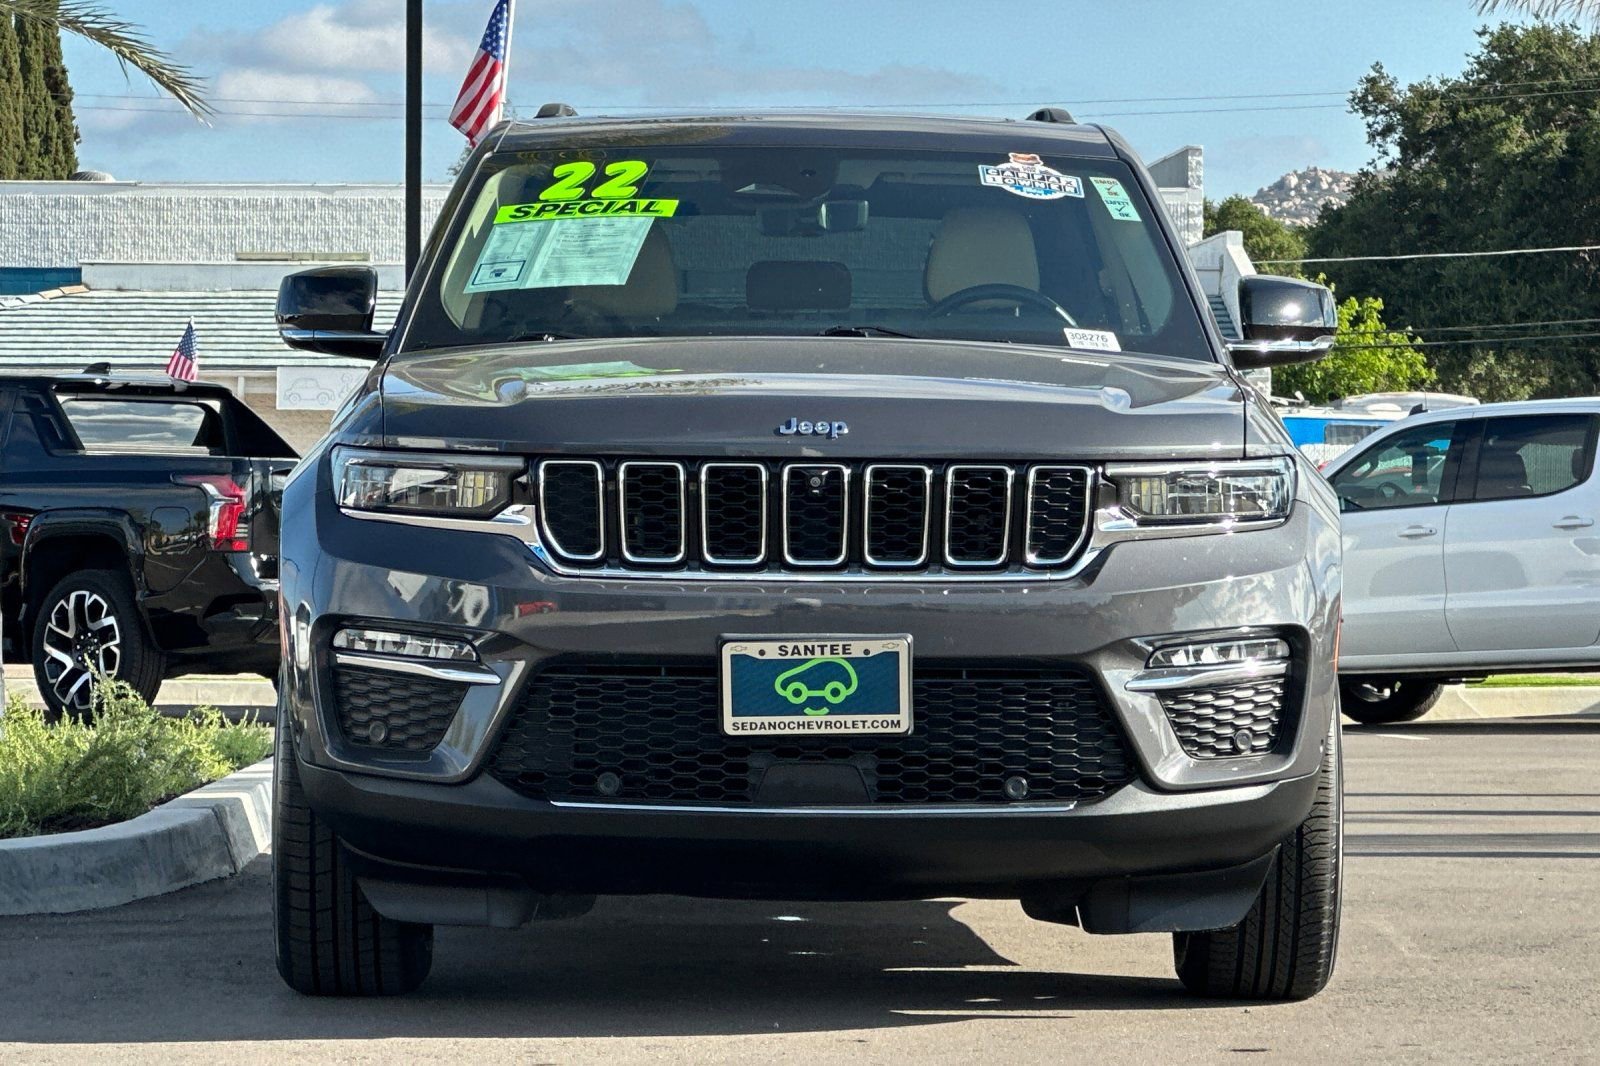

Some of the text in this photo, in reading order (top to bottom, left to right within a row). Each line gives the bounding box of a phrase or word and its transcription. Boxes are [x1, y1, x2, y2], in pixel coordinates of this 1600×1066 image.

[539, 160, 649, 200] 22
[987, 169, 1075, 188] CARFAX
[509, 200, 664, 220] SPECIAL
[779, 416, 849, 440] Jeep
[777, 643, 853, 657] SANTEE
[731, 719, 902, 732] SEDANOCHEVROLET.COM
